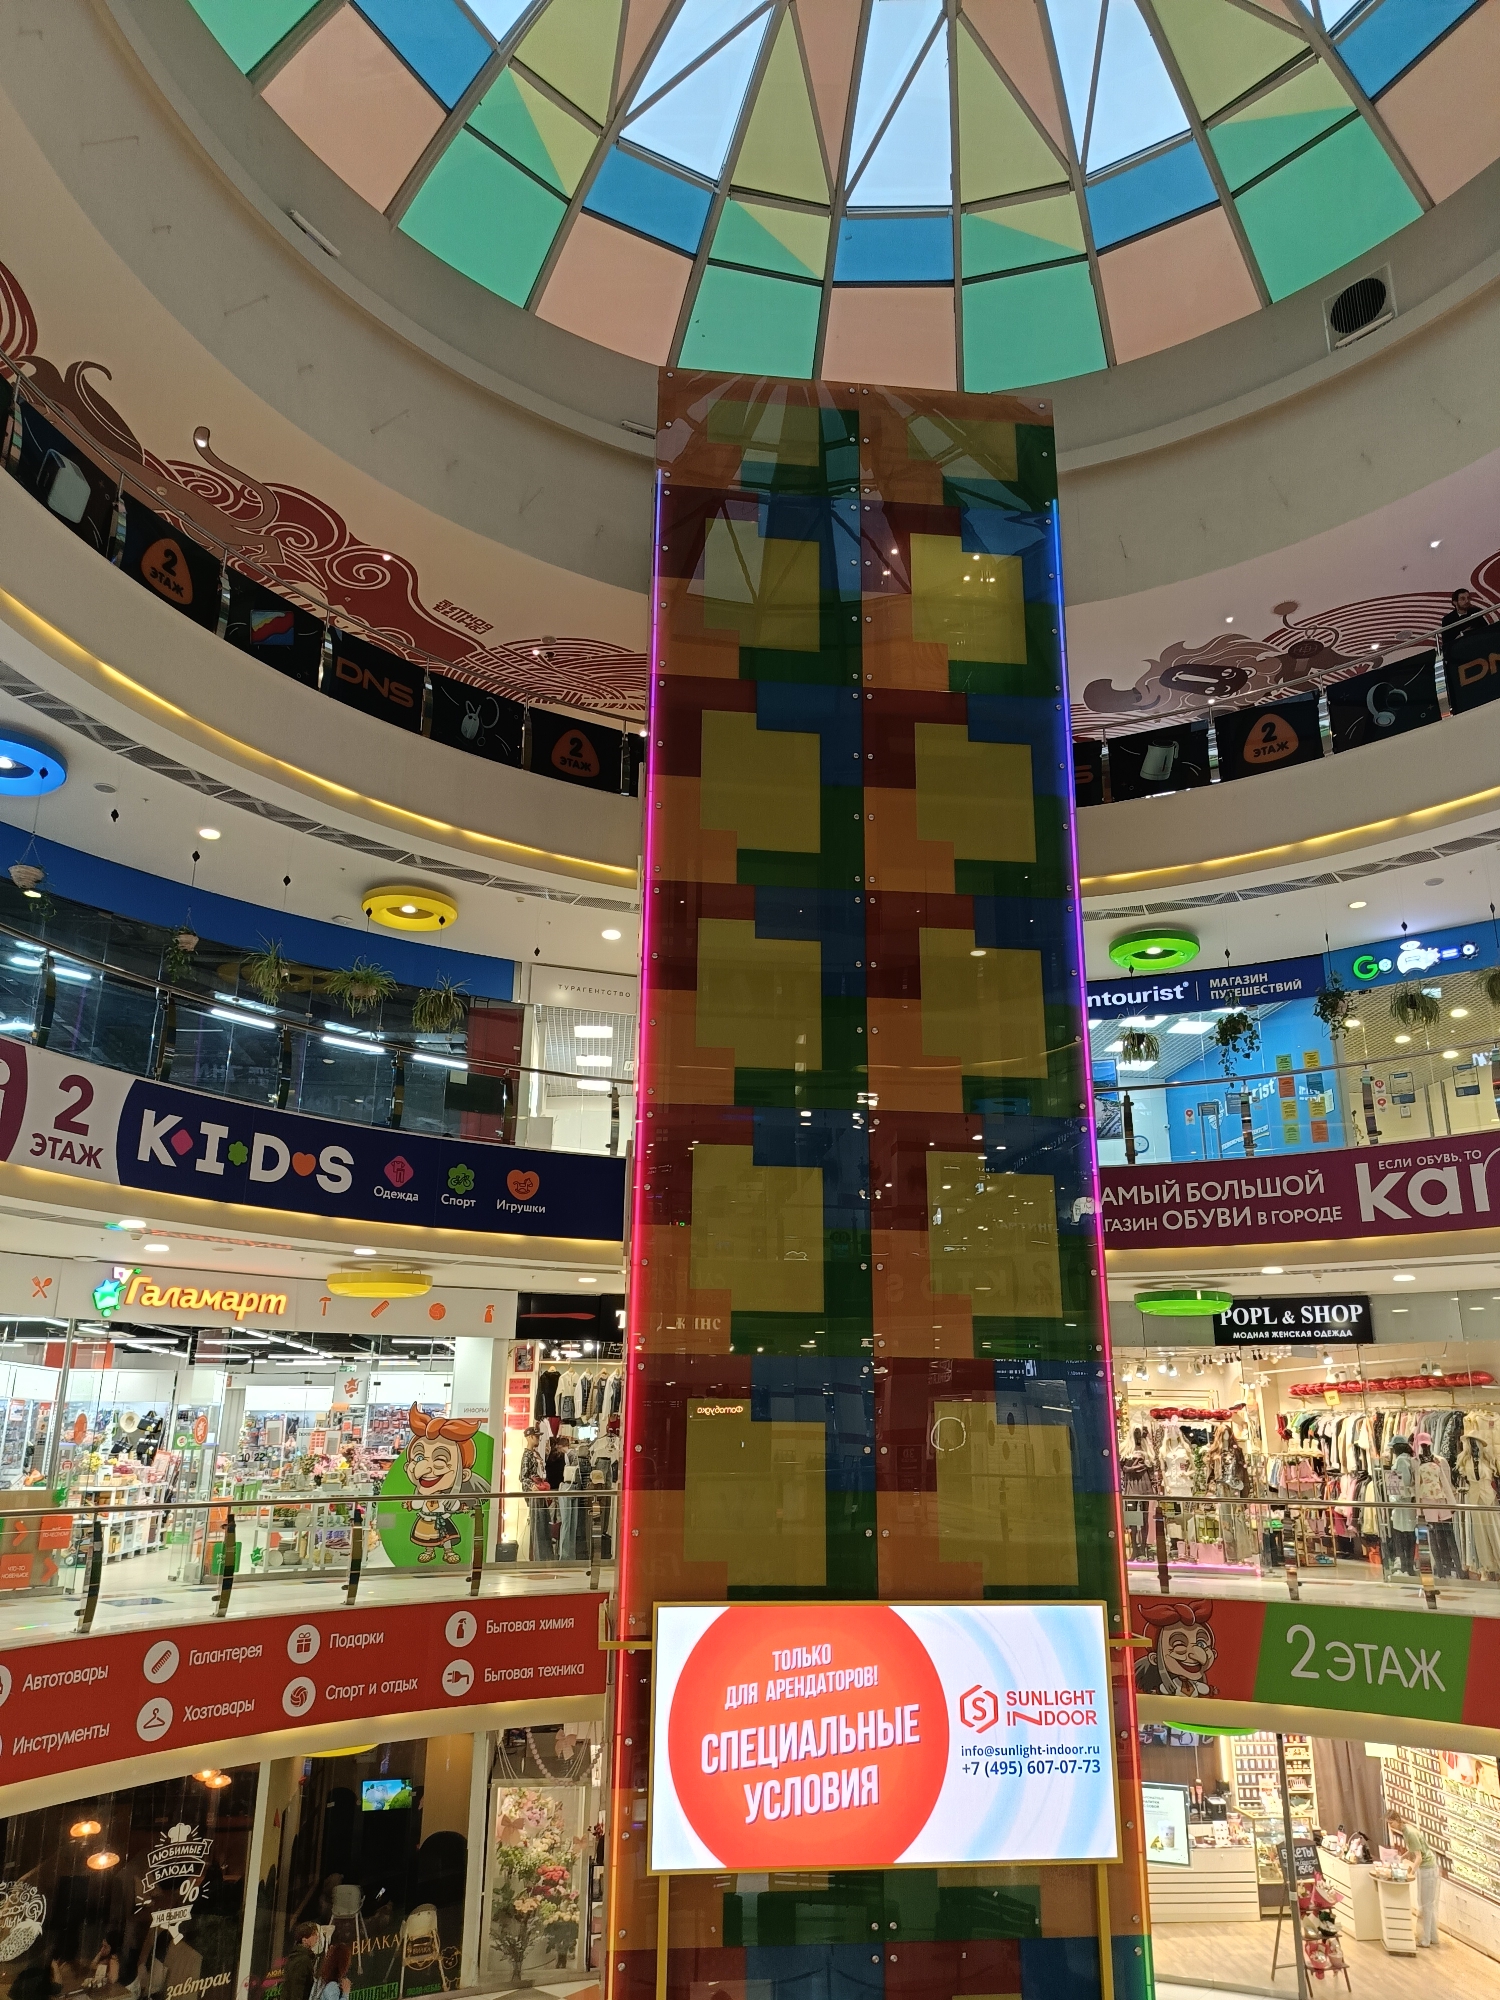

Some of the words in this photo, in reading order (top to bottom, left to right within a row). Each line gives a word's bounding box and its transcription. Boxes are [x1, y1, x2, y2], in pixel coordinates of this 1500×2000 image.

[162, 548, 178, 577] 2
[150, 566, 184, 598] ЭТАЖ
[335, 656, 414, 709] DNS
[1261, 722, 1278, 744] 2
[569, 737, 583, 758] 2
[1253, 740, 1290, 758] ЭТАЖ
[559, 756, 592, 773] ЭТАЖ
[558, 984, 631, 998] ТУРАГЕНТСТВО
[1209, 973, 1268, 989] МАГАЗИН
[1210, 979, 1302, 1000] ПУТЕШЕСТВИЙ
[53, 1074, 94, 1137] 2
[29, 1132, 104, 1170] ЭТАЖ
[1378, 1158, 1412, 1171] ЕСЛИ
[1416, 1153, 1462, 1166] ОБУВЬ,
[1463, 1149, 1482, 1161] ТО
[373, 1185, 419, 1202] Одежда
[1186, 1168, 1325, 1202] БОЛЬШОЙ
[440, 1193, 477, 1208] Спорт
[496, 1199, 546, 1214] Игрушки
[1162, 1206, 1252, 1231] ОБУВИ
[1257, 1211, 1268, 1226] В
[1271, 1205, 1343, 1225] ГОРОДЕ
[124, 1276, 288, 1321] Галамарт
[1220, 1306, 1278, 1326] POPL
[1282, 1310, 1295, 1325] &
[1301, 1304, 1364, 1324] SHOP
[1233, 1331, 1270, 1340] МОДНАЯ
[1271, 1331, 1312, 1339] ЖЕНСКАЯ
[1313, 1330, 1353, 1338] ОДЕЖДА
[254, 1452, 266, 1462] 22
[486, 1619, 536, 1634] Бытовая
[539, 1617, 575, 1631] химия
[329, 1631, 384, 1649] Подарки
[189, 1644, 263, 1667] Галантерея
[772, 1643, 832, 1672] ТОЛЬКО
[1286, 1624, 1320, 1679] 2
[1325, 1641, 1446, 1692] ЭТАЖ
[22, 1664, 109, 1693] Автотовары
[484, 1666, 534, 1682] Бытовая
[538, 1663, 585, 1678] техника
[325, 1682, 366, 1701] Спорт
[369, 1682, 377, 1694] и
[381, 1678, 418, 1694] отдых
[724, 1683, 758, 1710] ДЛЯ
[765, 1665, 879, 1702] АРЕНДАТОРОВ!
[1006, 1690, 1096, 1706] SUNLIGHT
[183, 1698, 255, 1723] Хозтовары
[1006, 1710, 1098, 1727] INDOOR
[12, 1723, 110, 1756] Инструменты
[701, 1703, 920, 1774] СПЕЦИАЛЬНЫЕ
[961, 1744, 1100, 1759] info@sunlight-indoor.ru
[962, 1762, 980, 1776] +7
[985, 1761, 1023, 1777] (495)
[1027, 1759, 1101, 1775] 607-07-73
[743, 1764, 879, 1824] УСЛОВИЯ
[152, 1845, 203, 1864] ЛЮБИМЫЕ
[154, 1863, 195, 1881] БЛЮДА
[156, 1912, 165, 1923] НА
[352, 1934, 401, 1956] ВИЛКА
[166, 1971, 232, 2000] завтрак
